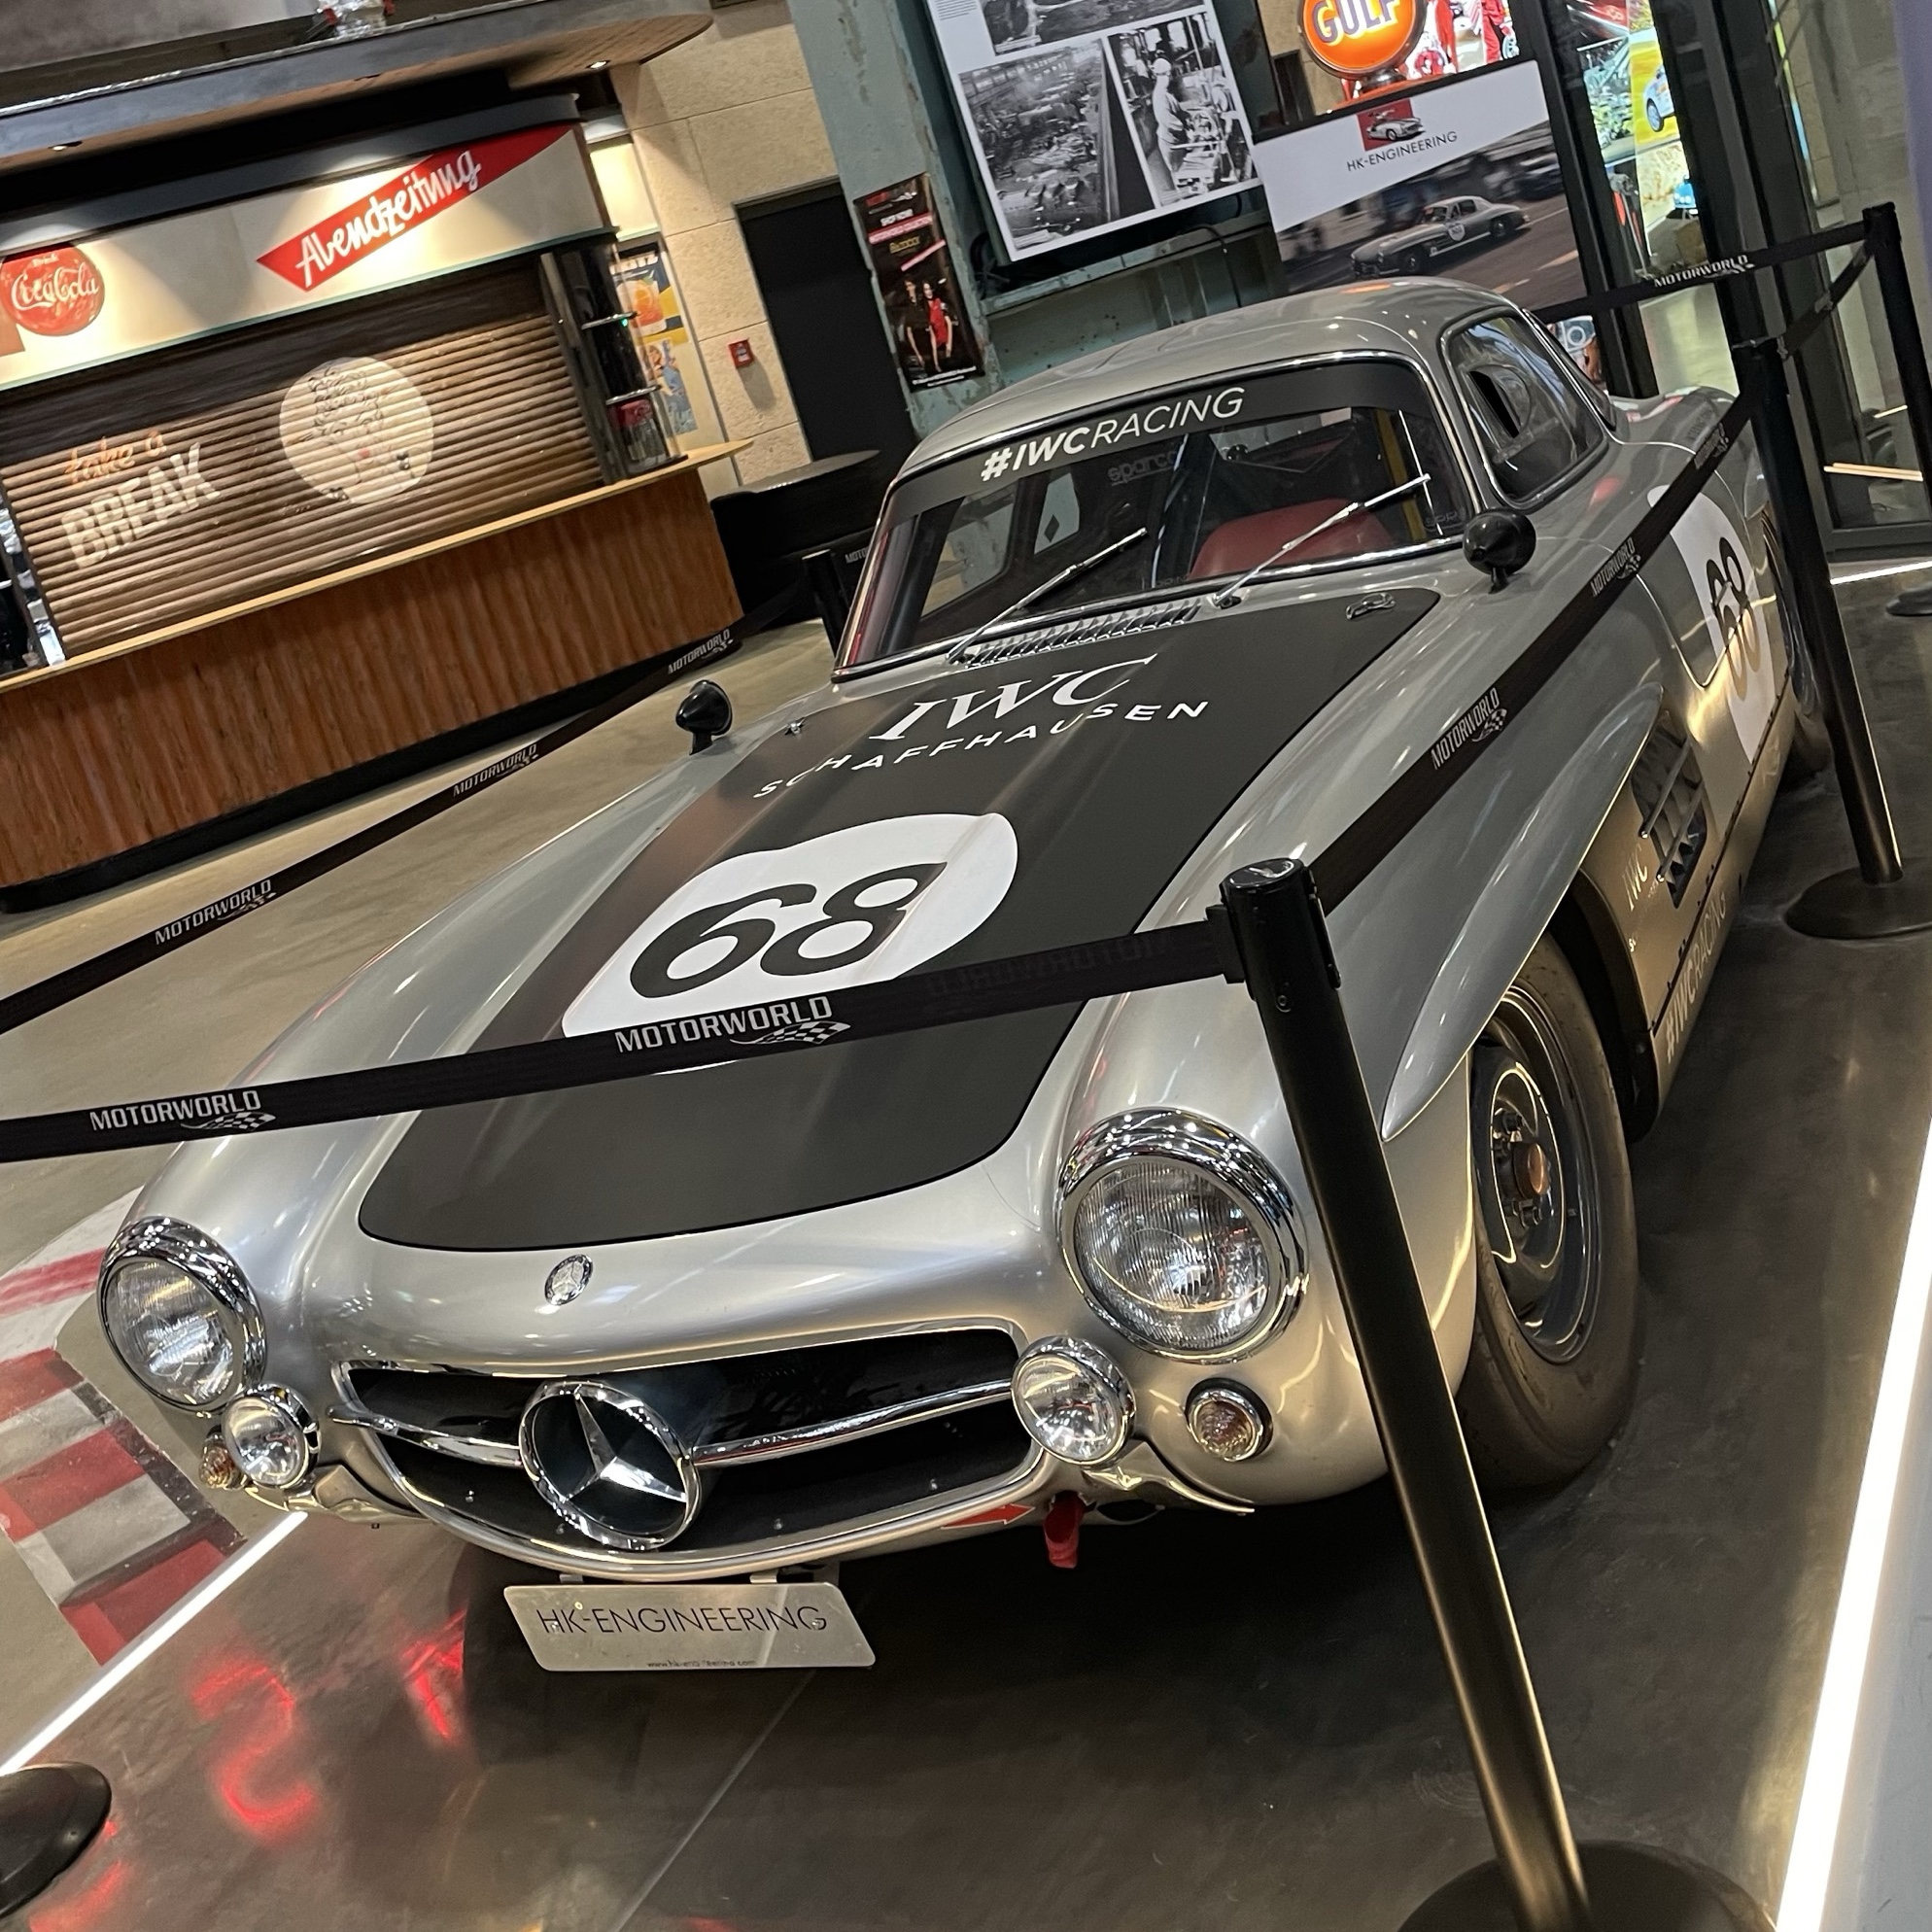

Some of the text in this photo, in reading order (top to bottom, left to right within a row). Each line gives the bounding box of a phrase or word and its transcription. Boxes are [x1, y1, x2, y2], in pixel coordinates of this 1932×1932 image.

[1347, 131, 1458, 172] HK-ENGINEERING
[295, 150, 482, 288] Abendzeitung
[1654, 254, 1748, 288] MOTORWORLD
[61, 442, 222, 569] BREAK
[668, 628, 731, 674] MOTORWORLD
[869, 653, 1157, 742] IWC
[753, 701, 1209, 799] SCHAFFHAUSEN
[1431, 687, 1501, 771] MOTORWORLD
[452, 743, 537, 797] MOTORWORLD
[155, 879, 272, 946] MOTORWORLD
[630, 862, 948, 999] 68
[614, 995, 833, 1052] MOTORWORLD
[89, 1089, 261, 1131] MOTORWORLD
[536, 1606, 827, 1634] HK-ENGINEERING
